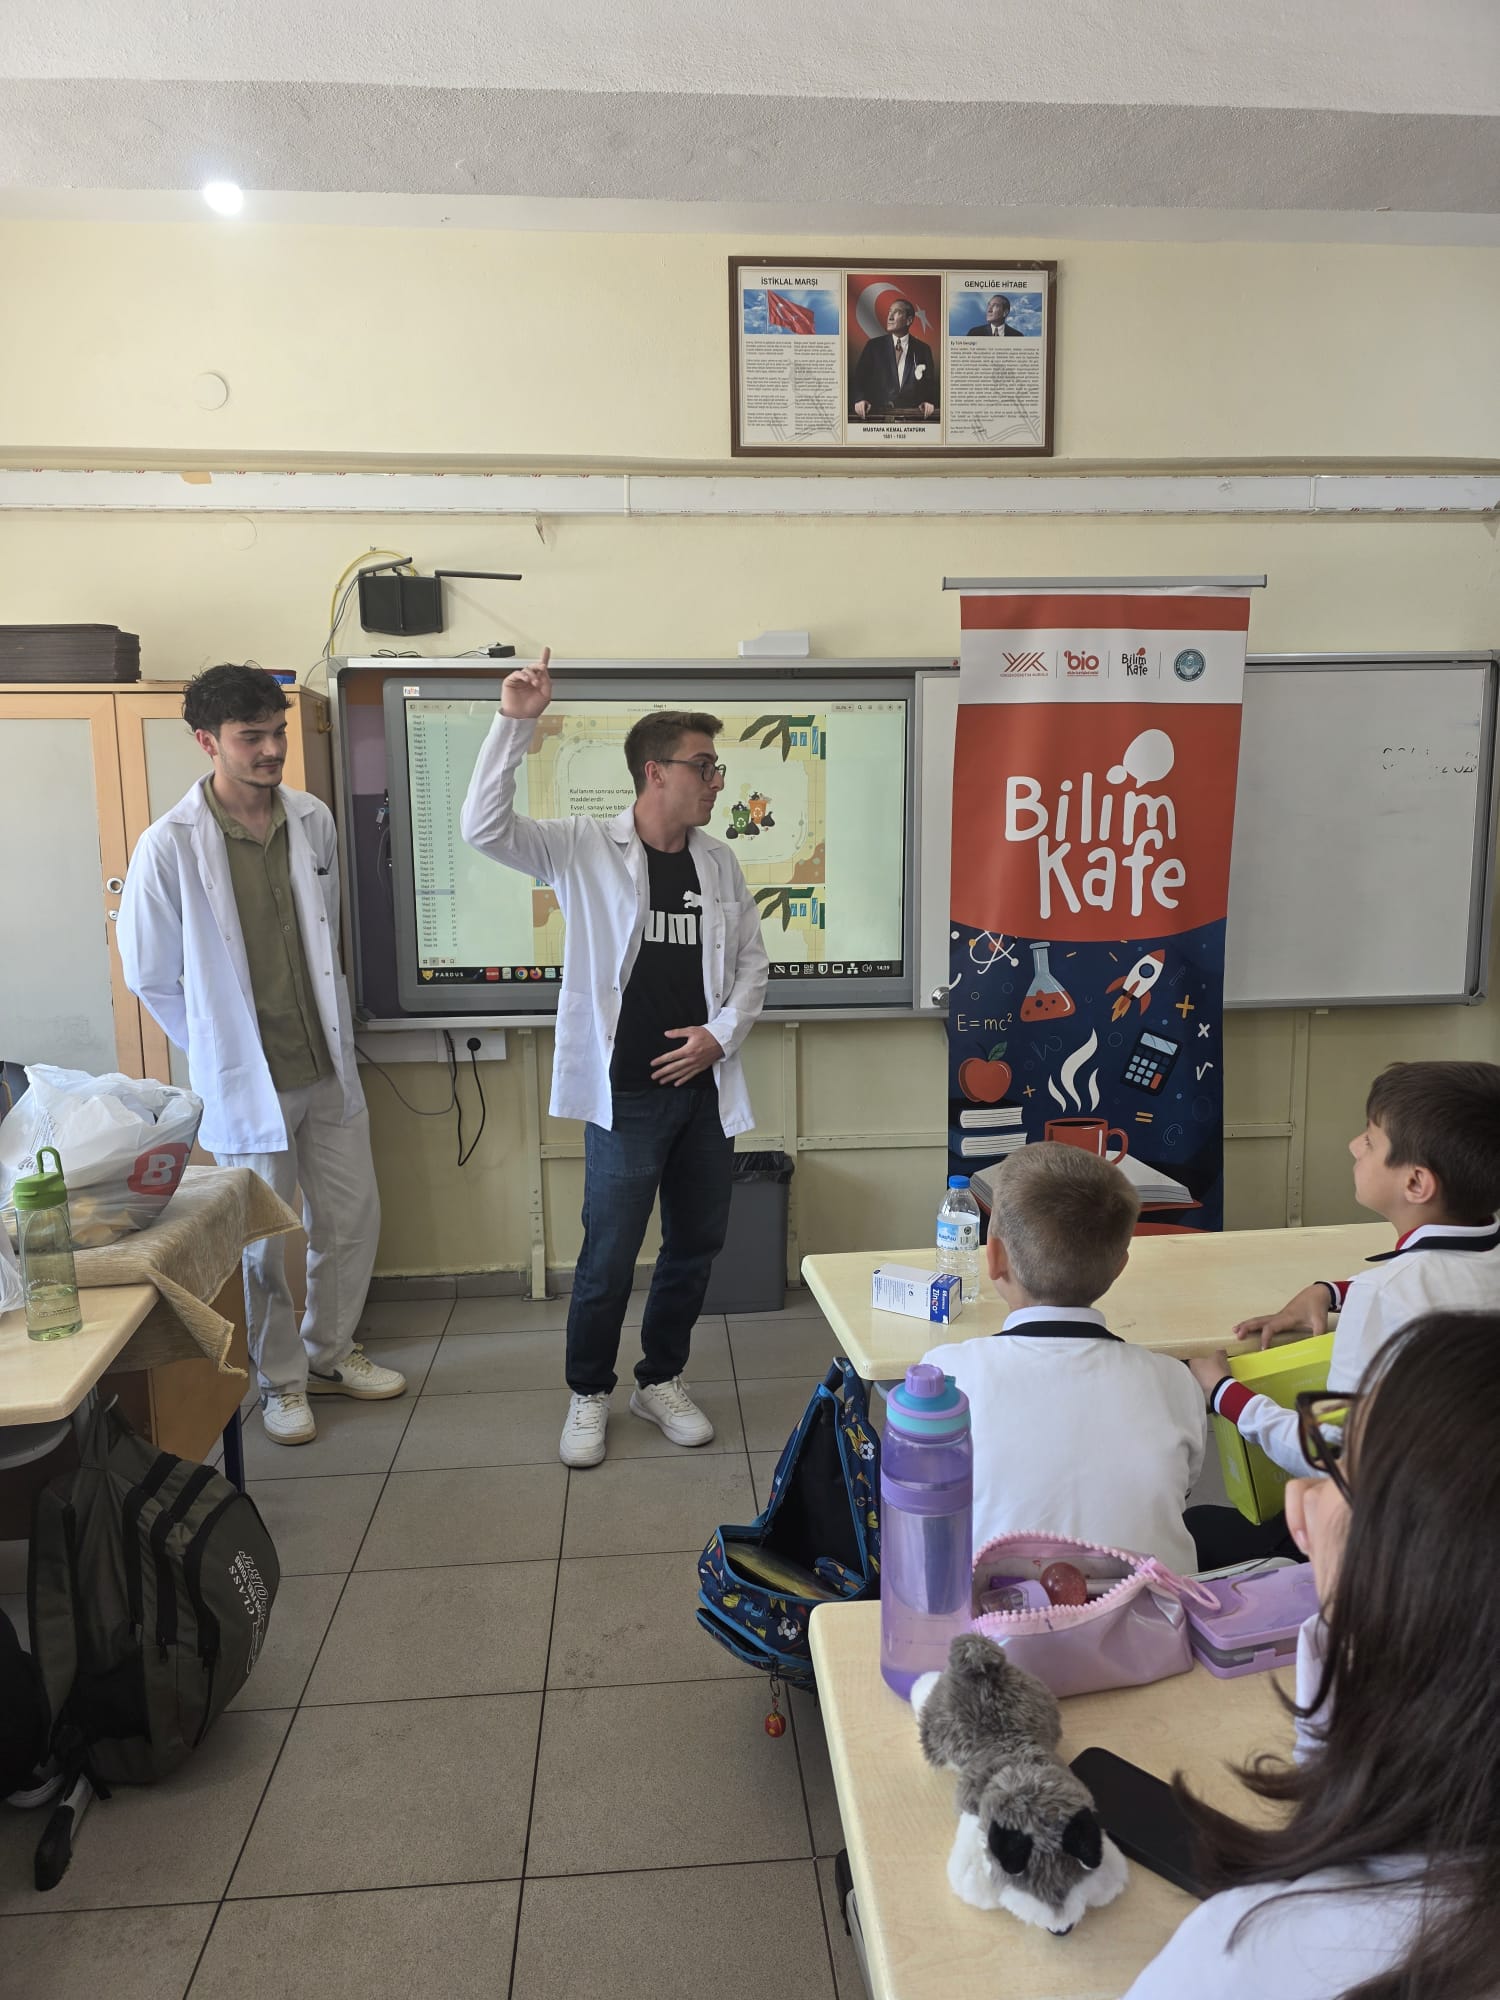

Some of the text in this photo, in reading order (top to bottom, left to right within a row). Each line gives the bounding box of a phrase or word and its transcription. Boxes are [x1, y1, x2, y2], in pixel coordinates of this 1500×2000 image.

[761, 277, 818, 287] İSTİKLAL MARŞI
[964, 280, 1028, 290] GENÇLİĞE HİTABE
[1121, 653, 1147, 665] Bilim
[1004, 771, 1177, 846] Bilim
[1037, 828, 1187, 920] Kafe
[228, 1565, 255, 1615] CLASS
